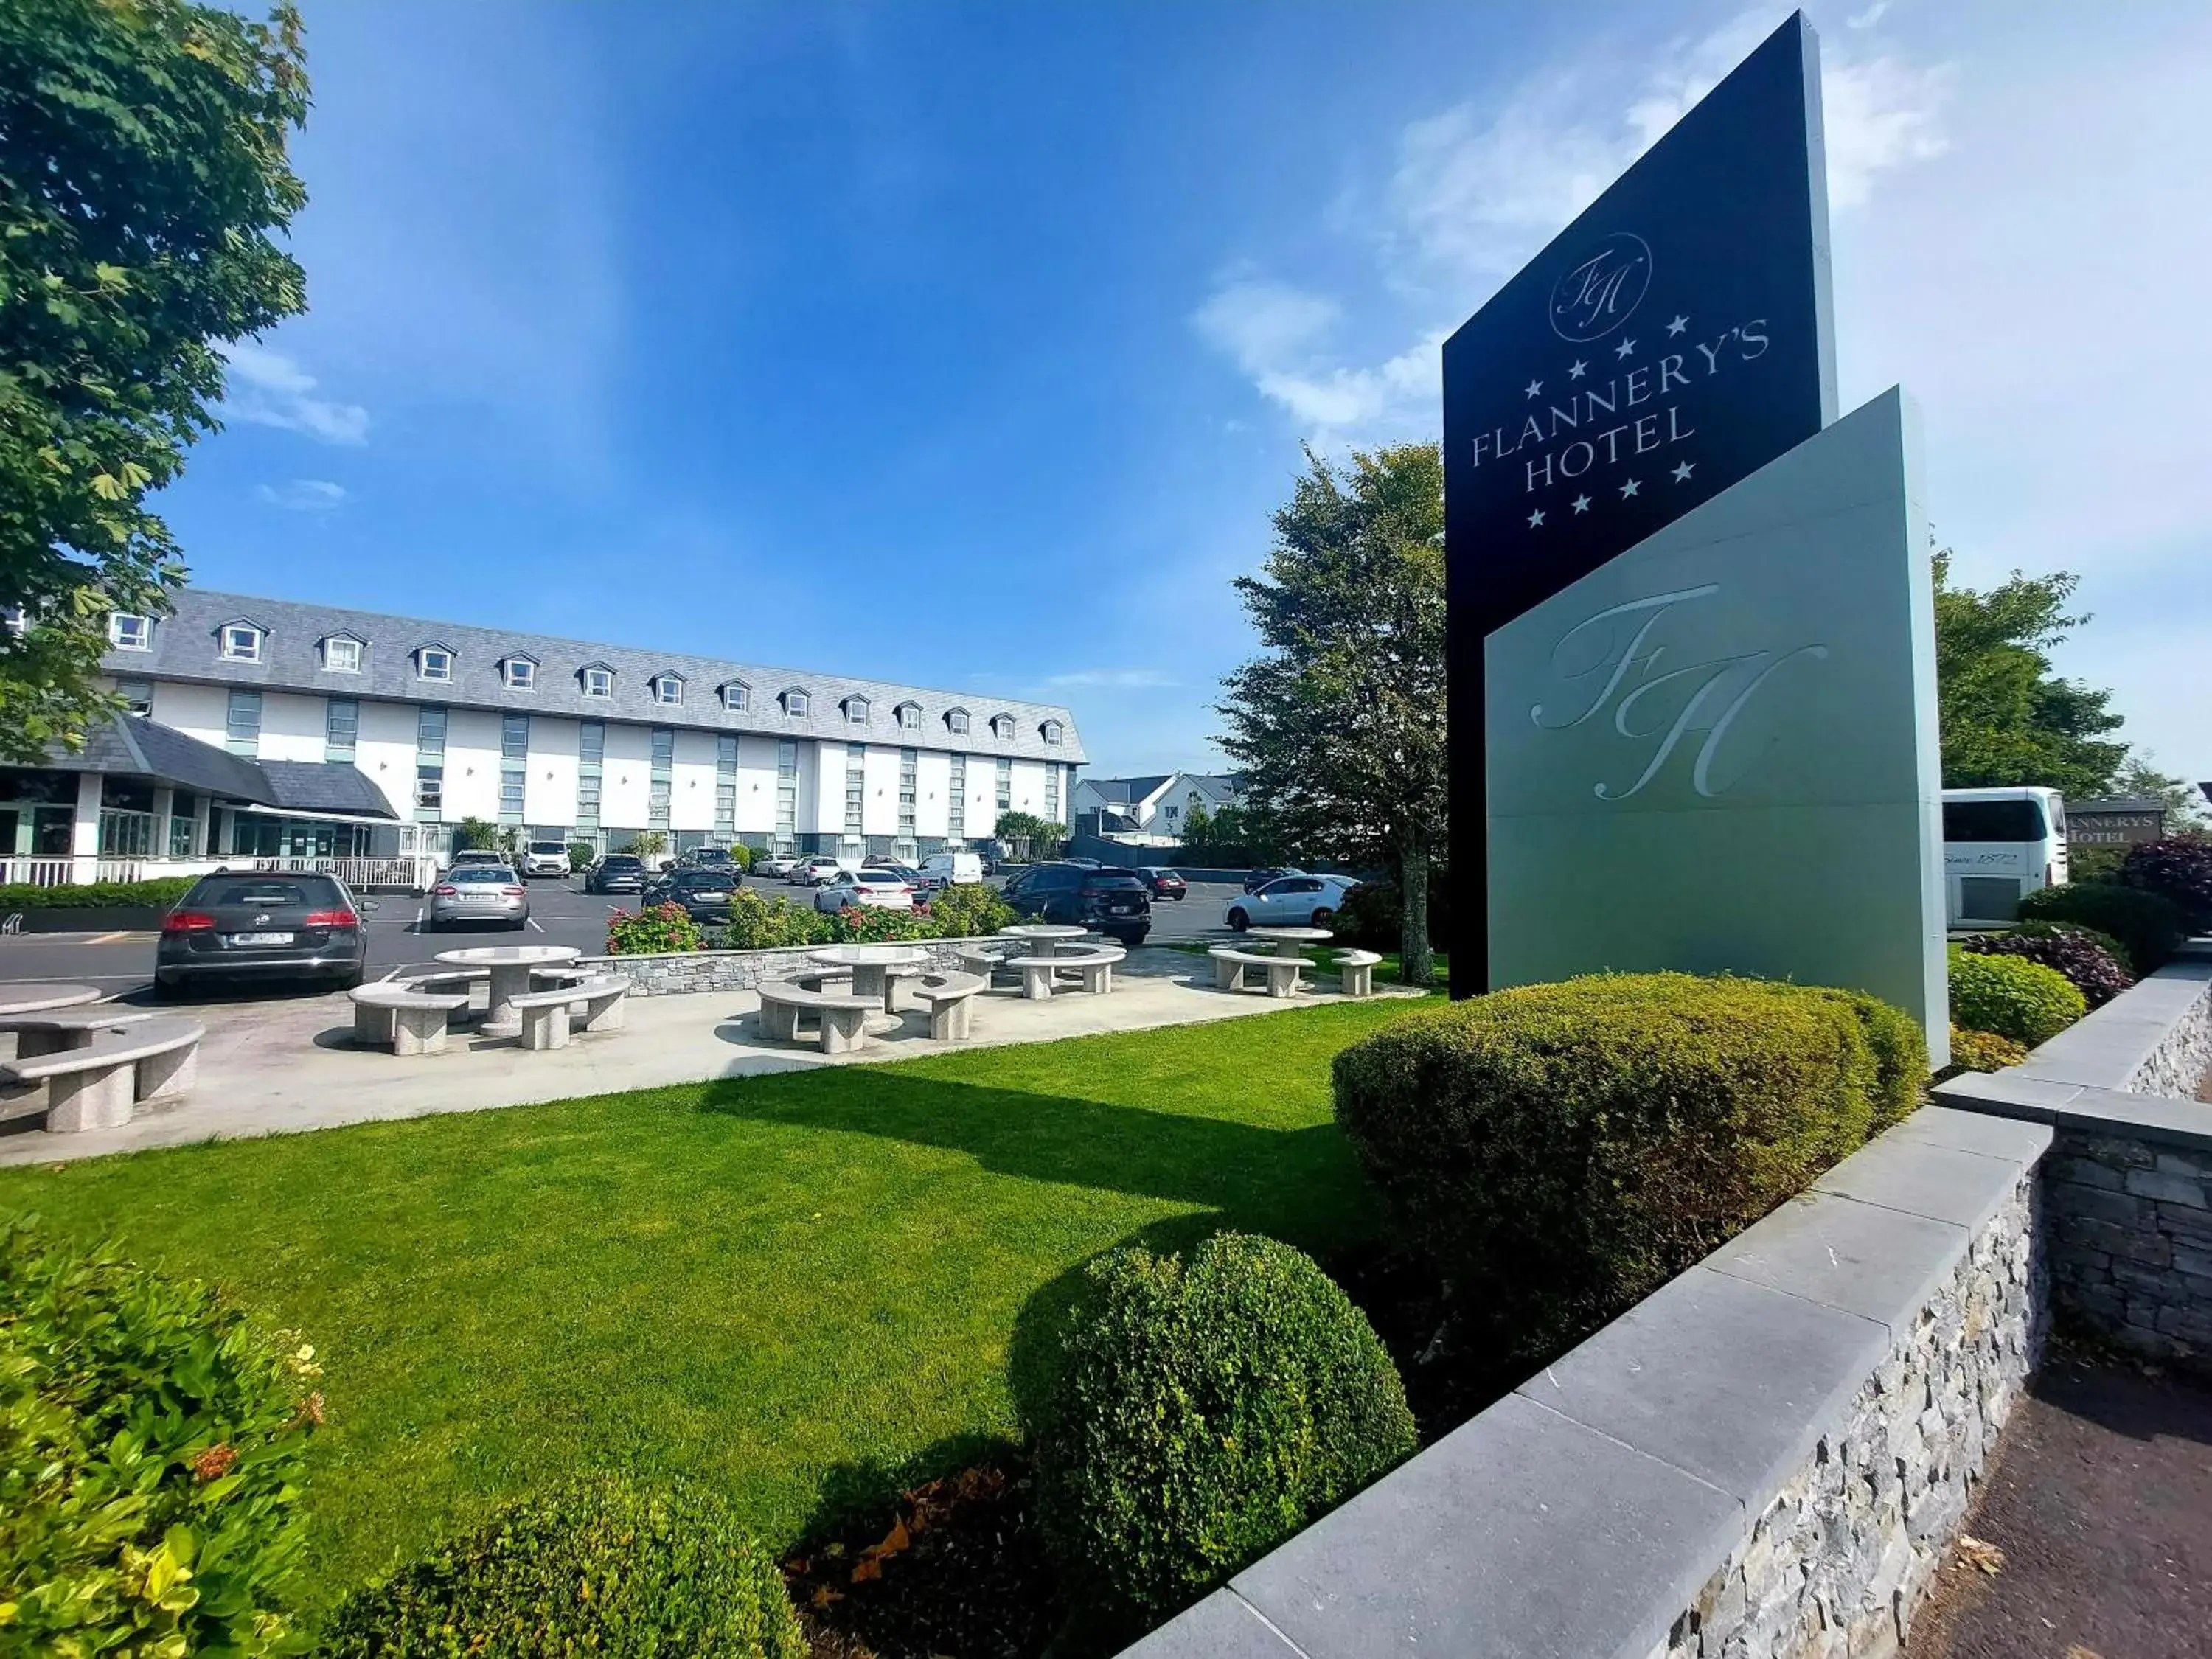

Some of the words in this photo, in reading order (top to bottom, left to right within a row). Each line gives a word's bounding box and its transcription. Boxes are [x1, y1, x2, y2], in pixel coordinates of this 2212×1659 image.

[1472, 319, 1770, 469] FLANNERY'S
[1526, 406, 1695, 493] HOTEL
[2066, 815, 2154, 827] ANNERYS
